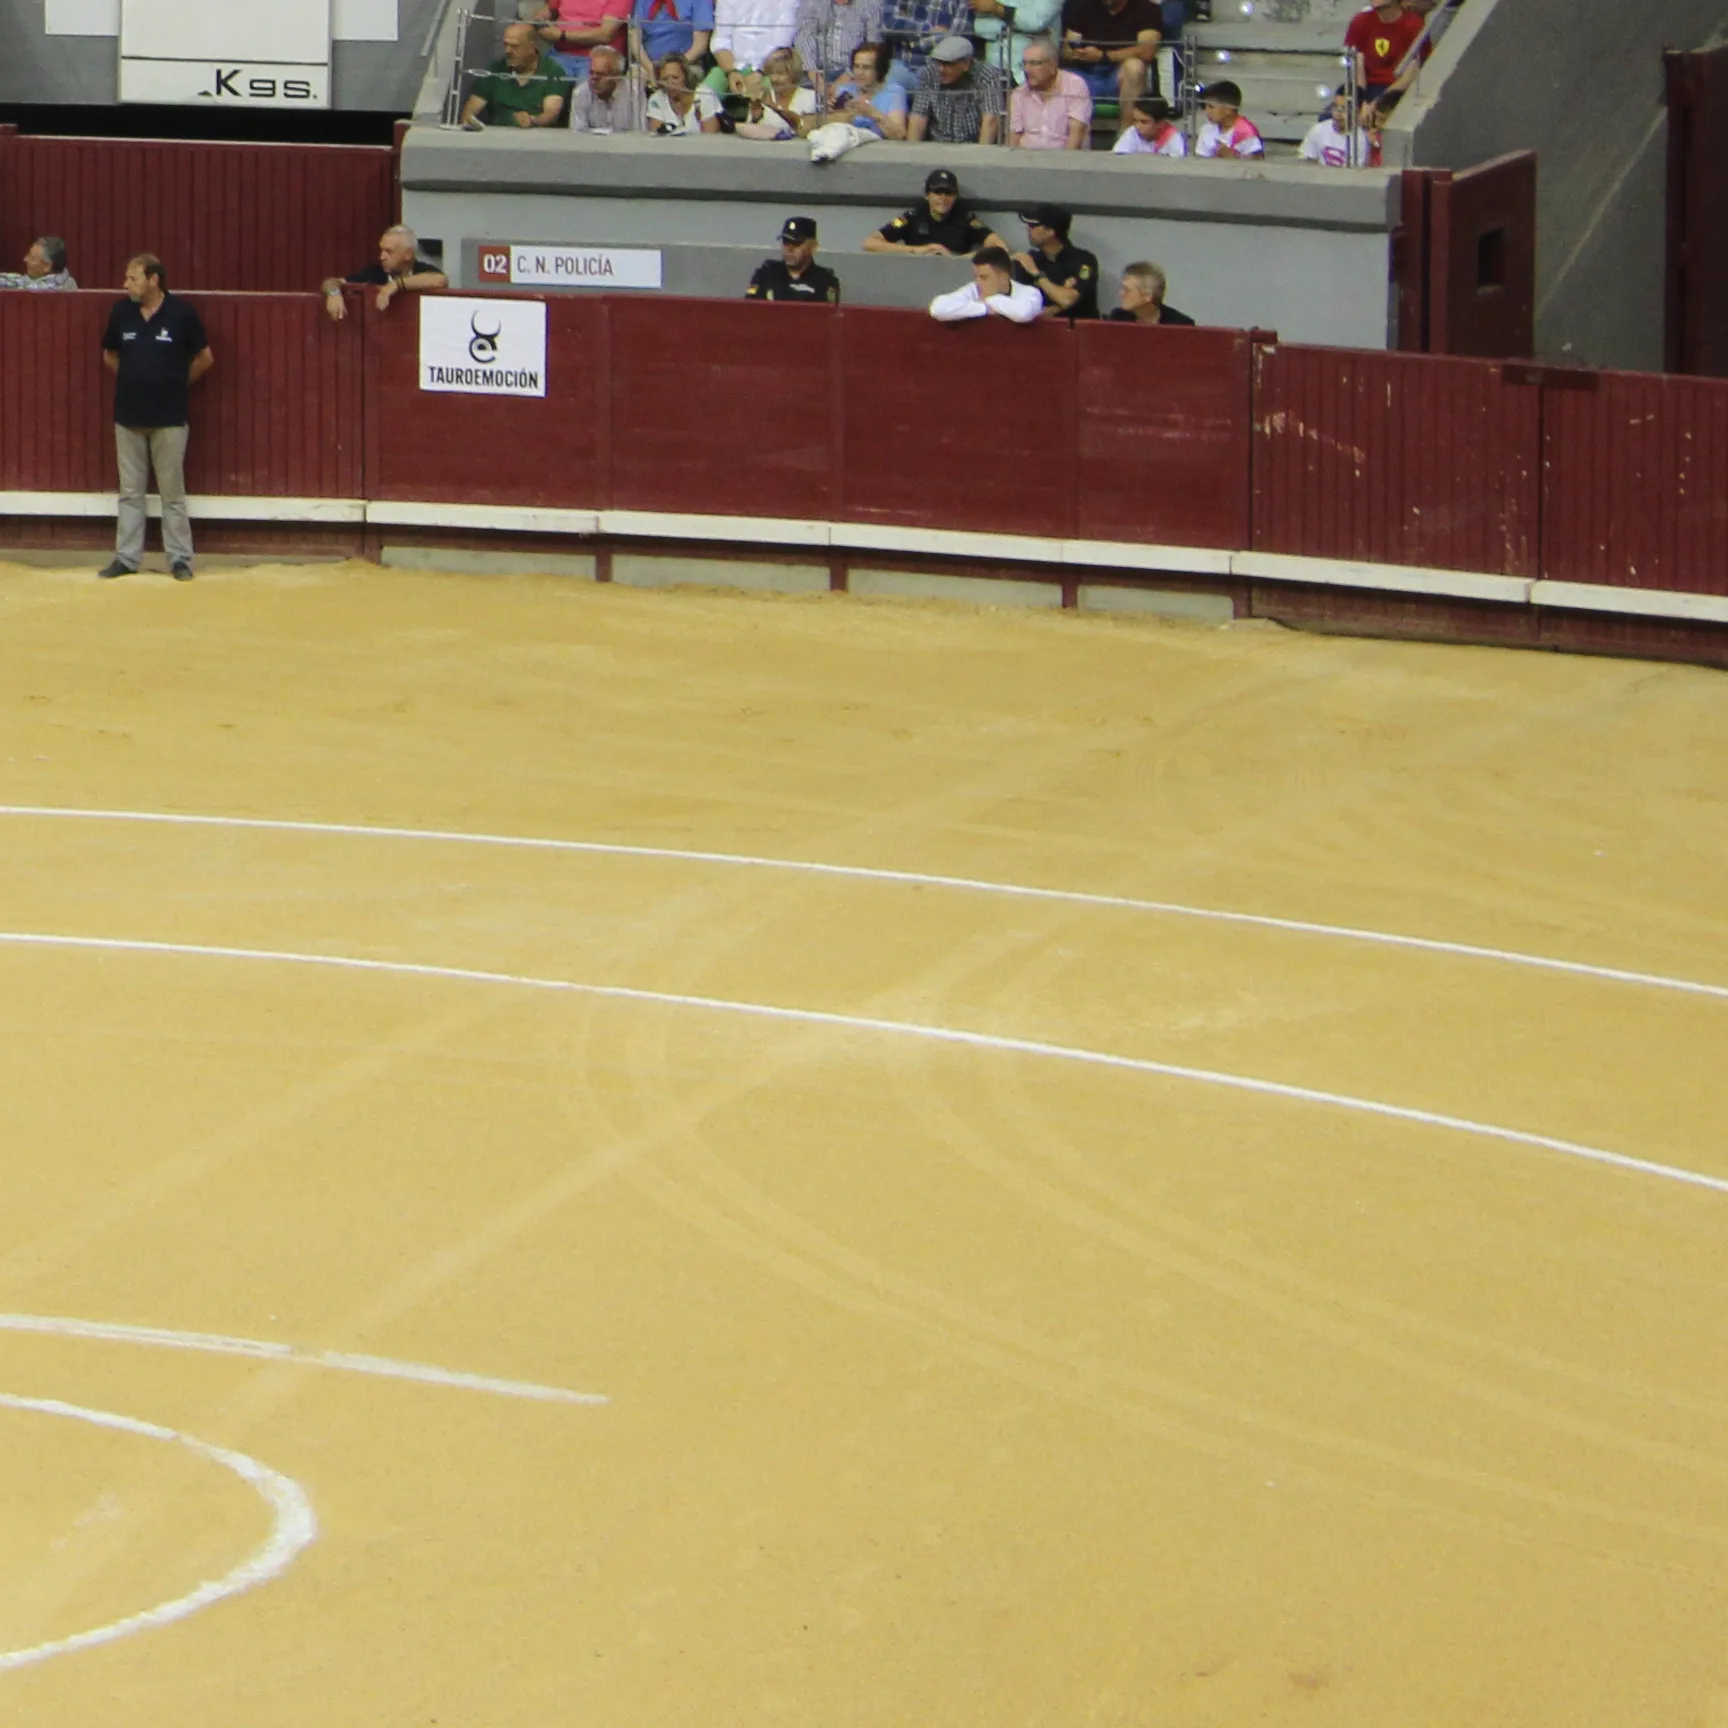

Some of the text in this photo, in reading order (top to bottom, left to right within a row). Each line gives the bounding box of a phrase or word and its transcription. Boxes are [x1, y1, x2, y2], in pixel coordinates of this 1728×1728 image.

[215, 69, 318, 100] Kgs.
[484, 253, 613, 277] 02 C. N. POLICÍA
[428, 365, 539, 389] TAUROEMOCIÓN
